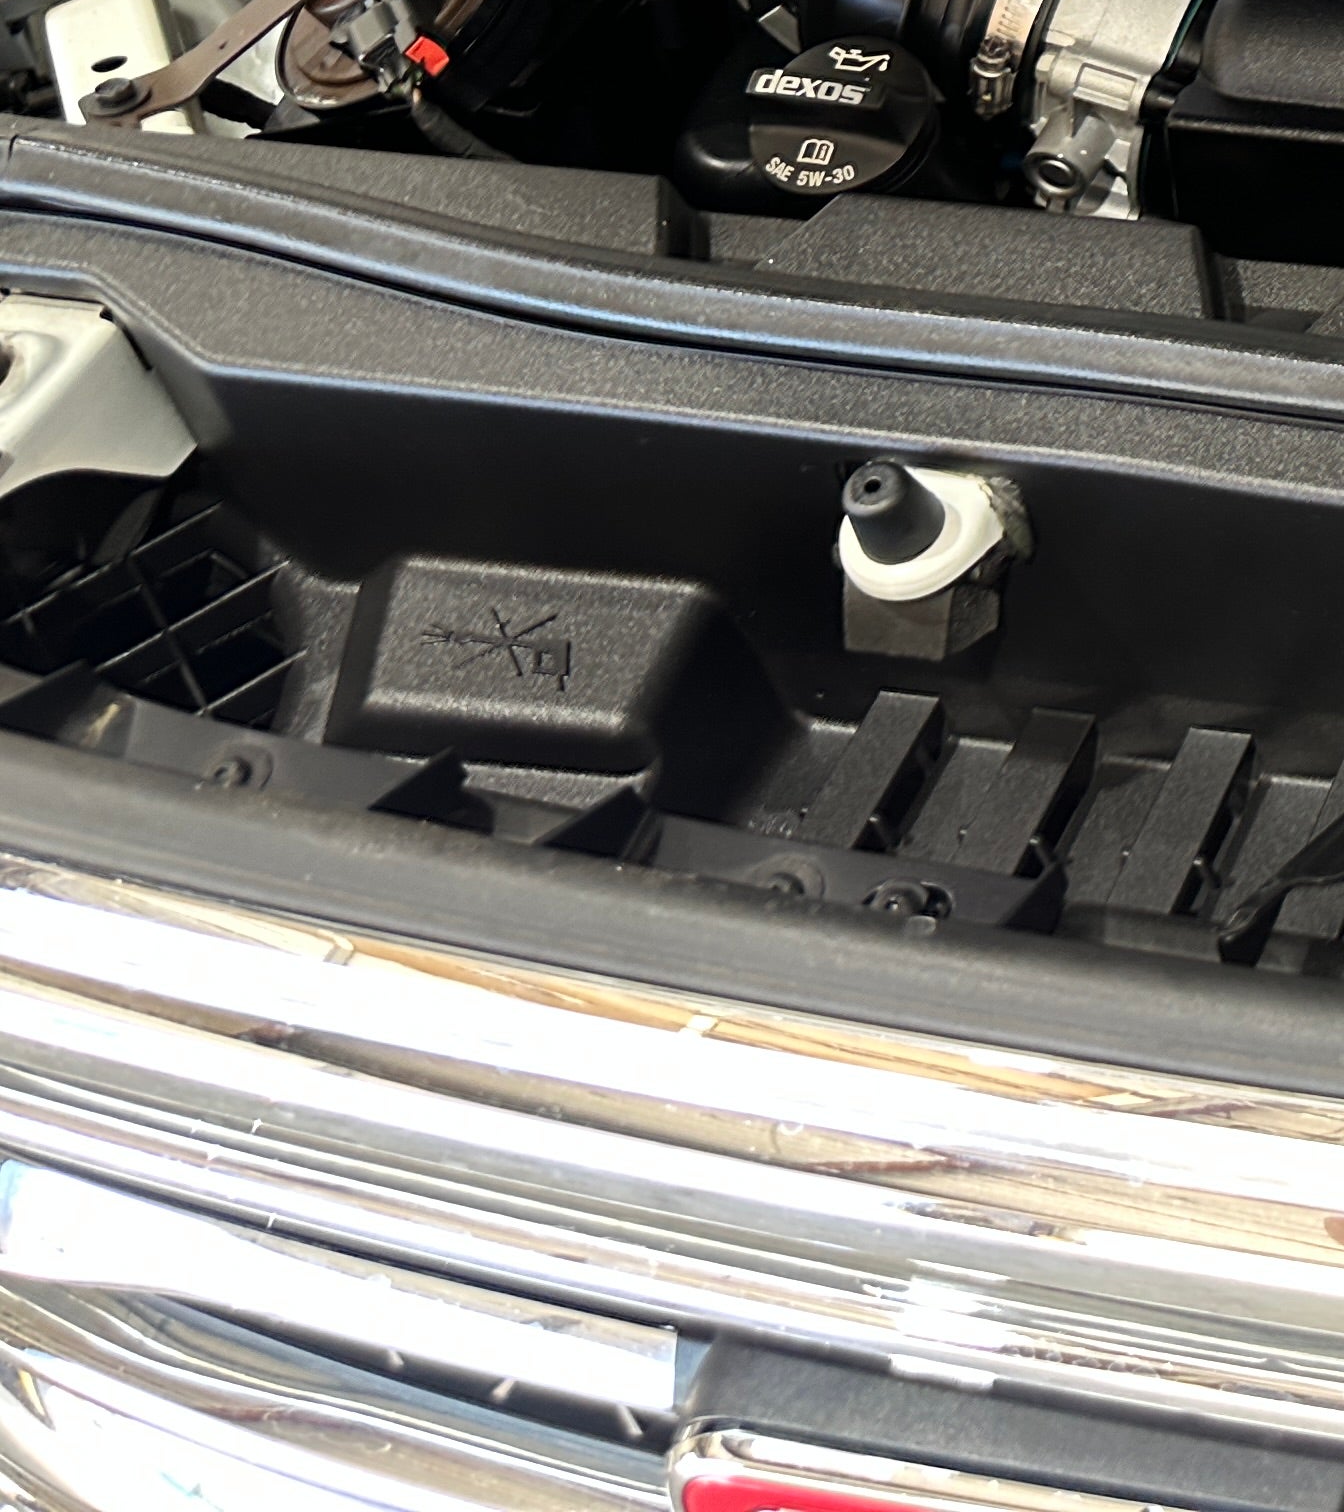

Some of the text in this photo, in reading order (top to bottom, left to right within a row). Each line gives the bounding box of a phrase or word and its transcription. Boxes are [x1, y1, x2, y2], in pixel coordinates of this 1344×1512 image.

[755, 69, 866, 105] dexos
[765, 156, 856, 187] SAE 5W-30
